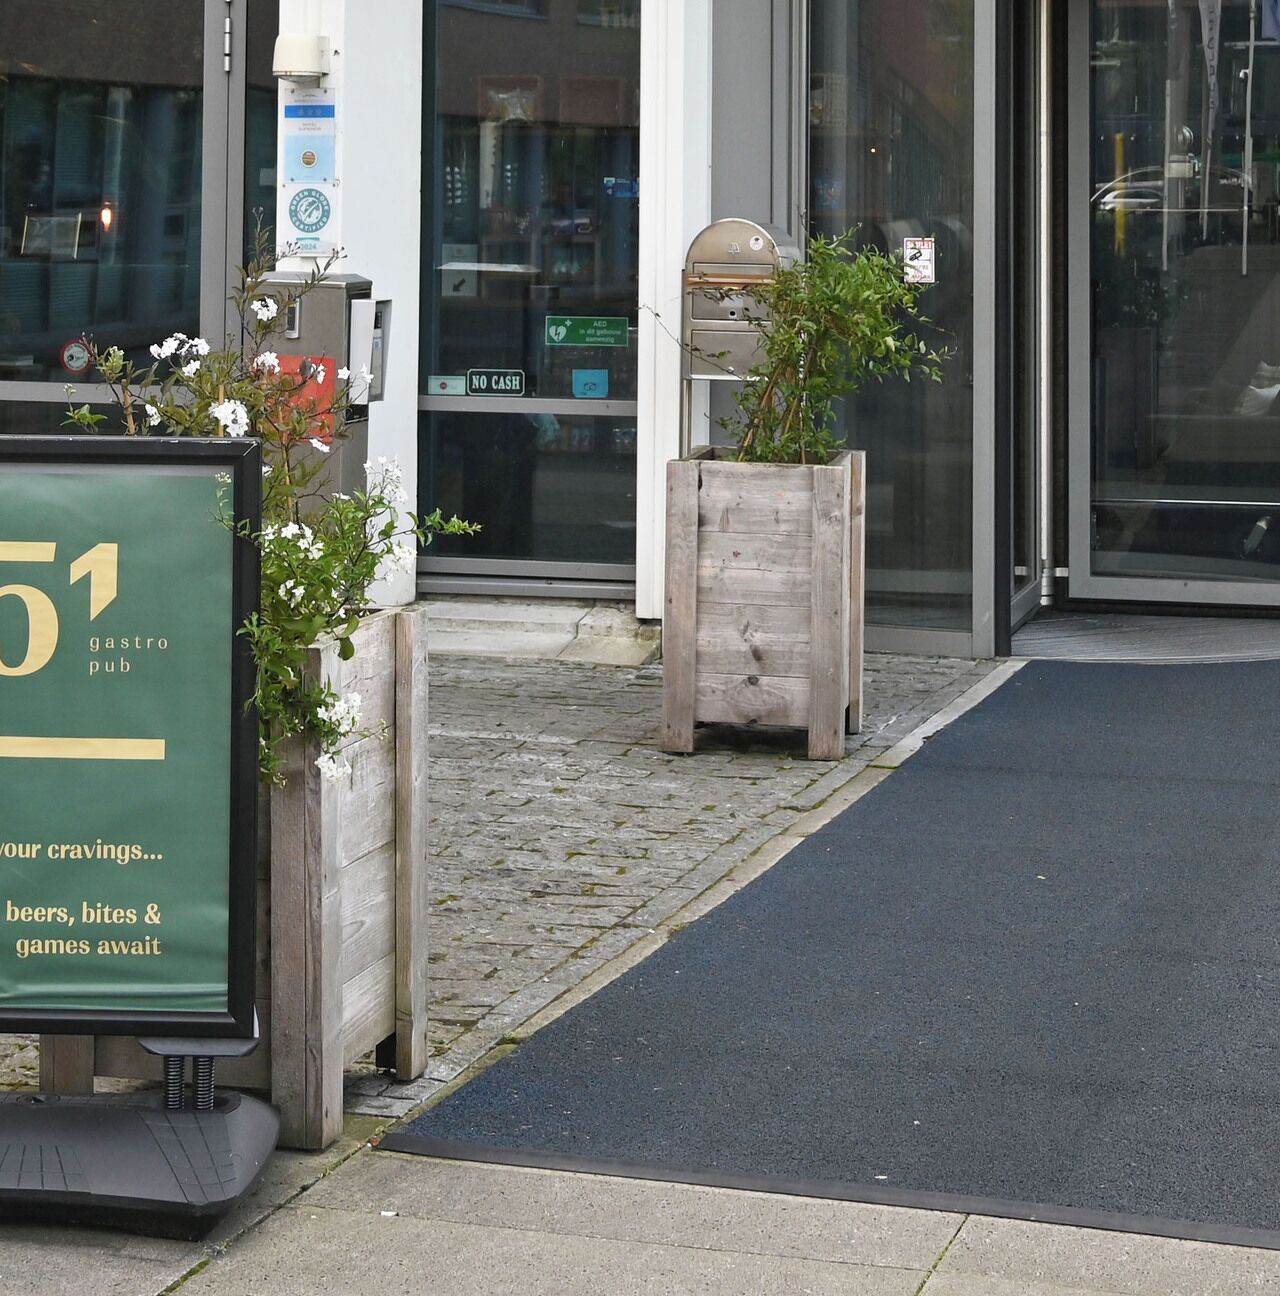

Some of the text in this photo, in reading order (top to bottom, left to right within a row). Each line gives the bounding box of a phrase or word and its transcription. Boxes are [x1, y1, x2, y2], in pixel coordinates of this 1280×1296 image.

[472, 375, 521, 391] NO CASH
[89, 635, 169, 652] gastro
[89, 657, 132, 674] pub
[47, 836, 164, 865] cravings...
[6, 900, 162, 926] beers, bites &
[16, 935, 162, 960] games await
